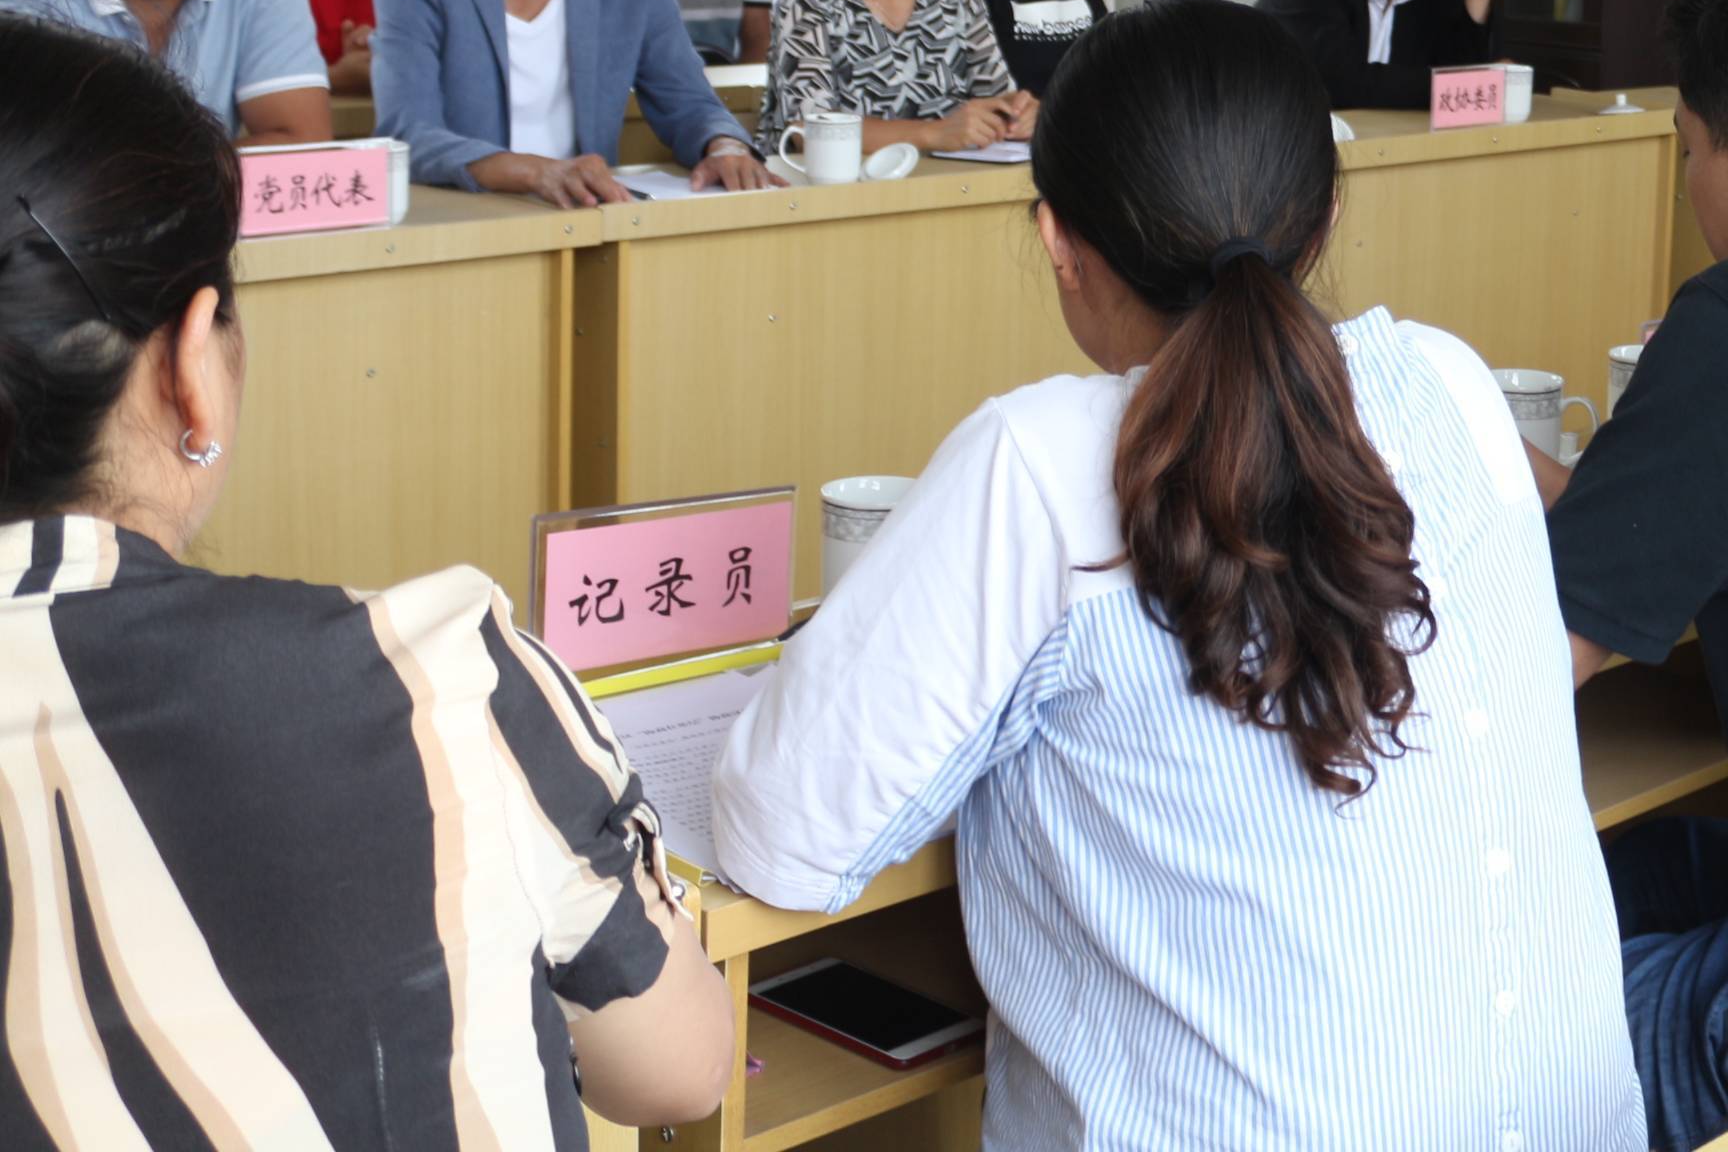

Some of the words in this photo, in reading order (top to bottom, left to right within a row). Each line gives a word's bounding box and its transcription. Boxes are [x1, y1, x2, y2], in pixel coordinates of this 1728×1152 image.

[253, 169, 376, 214] 党员代表
[568, 546, 753, 627] 记录员
